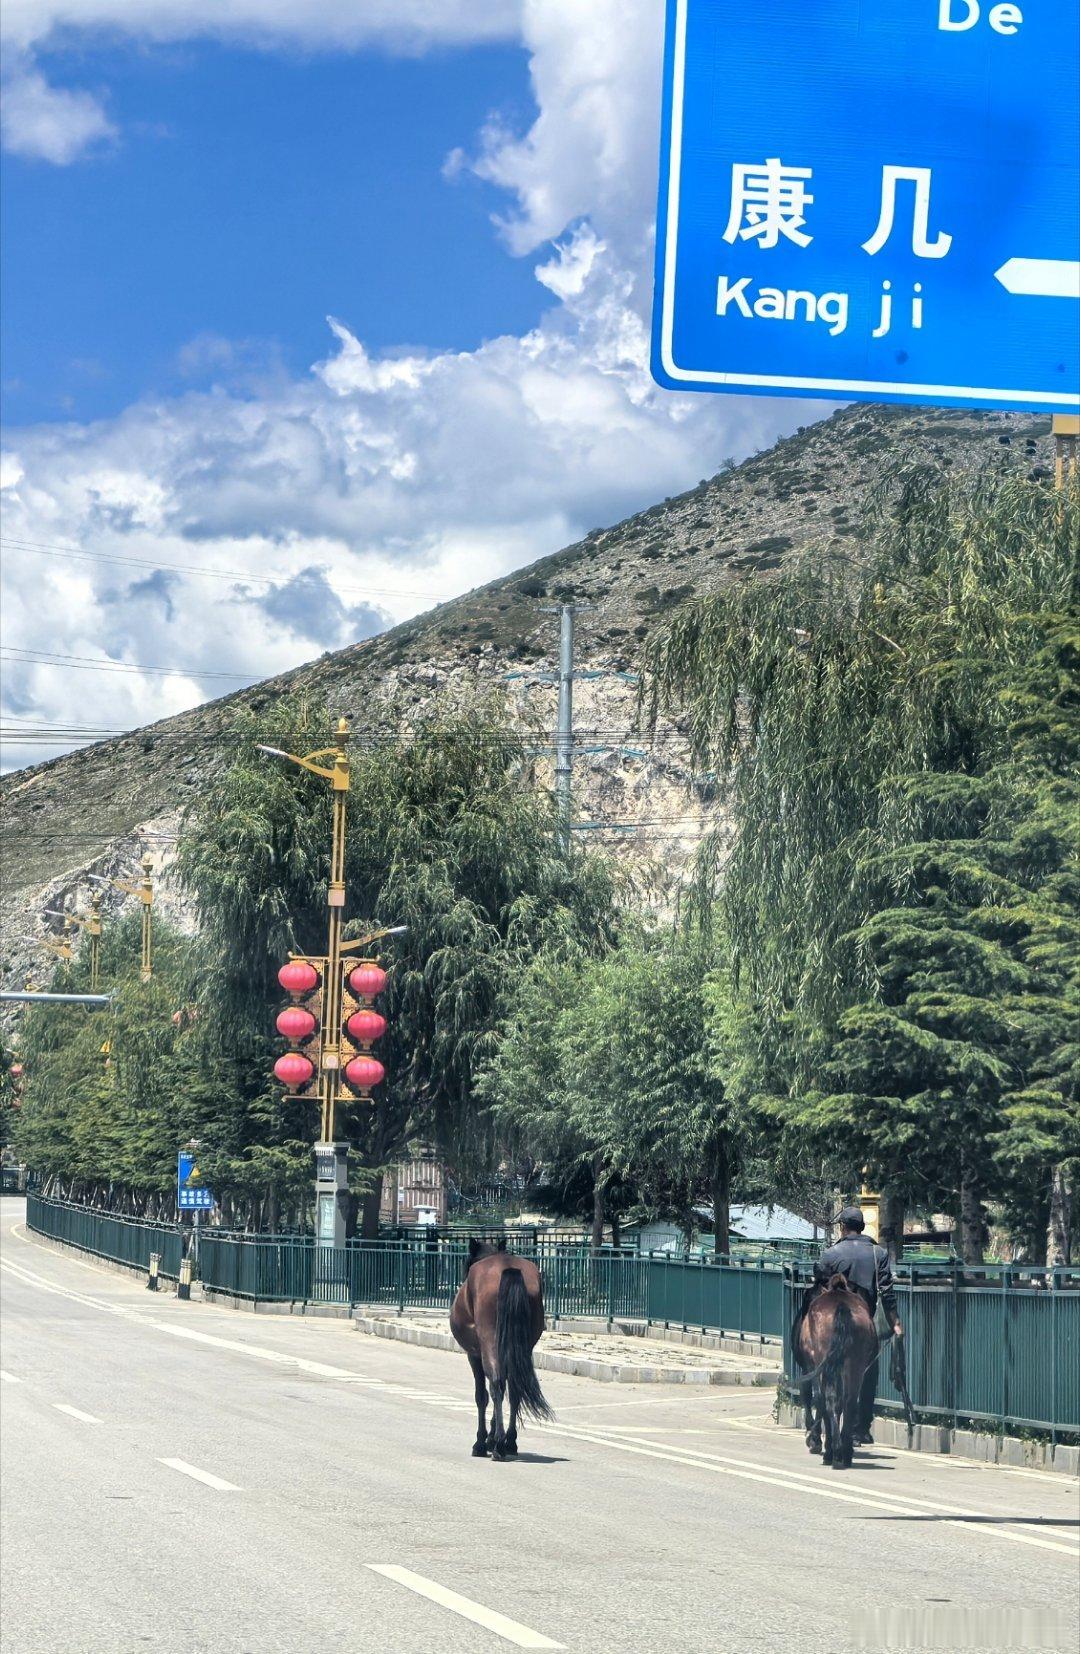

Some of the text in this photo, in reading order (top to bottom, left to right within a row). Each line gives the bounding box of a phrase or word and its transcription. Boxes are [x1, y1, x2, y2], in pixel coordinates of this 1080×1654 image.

[938, 0, 1023, 35] De
[722, 158, 953, 259] 康几
[716, 276, 923, 338] Kang ji
